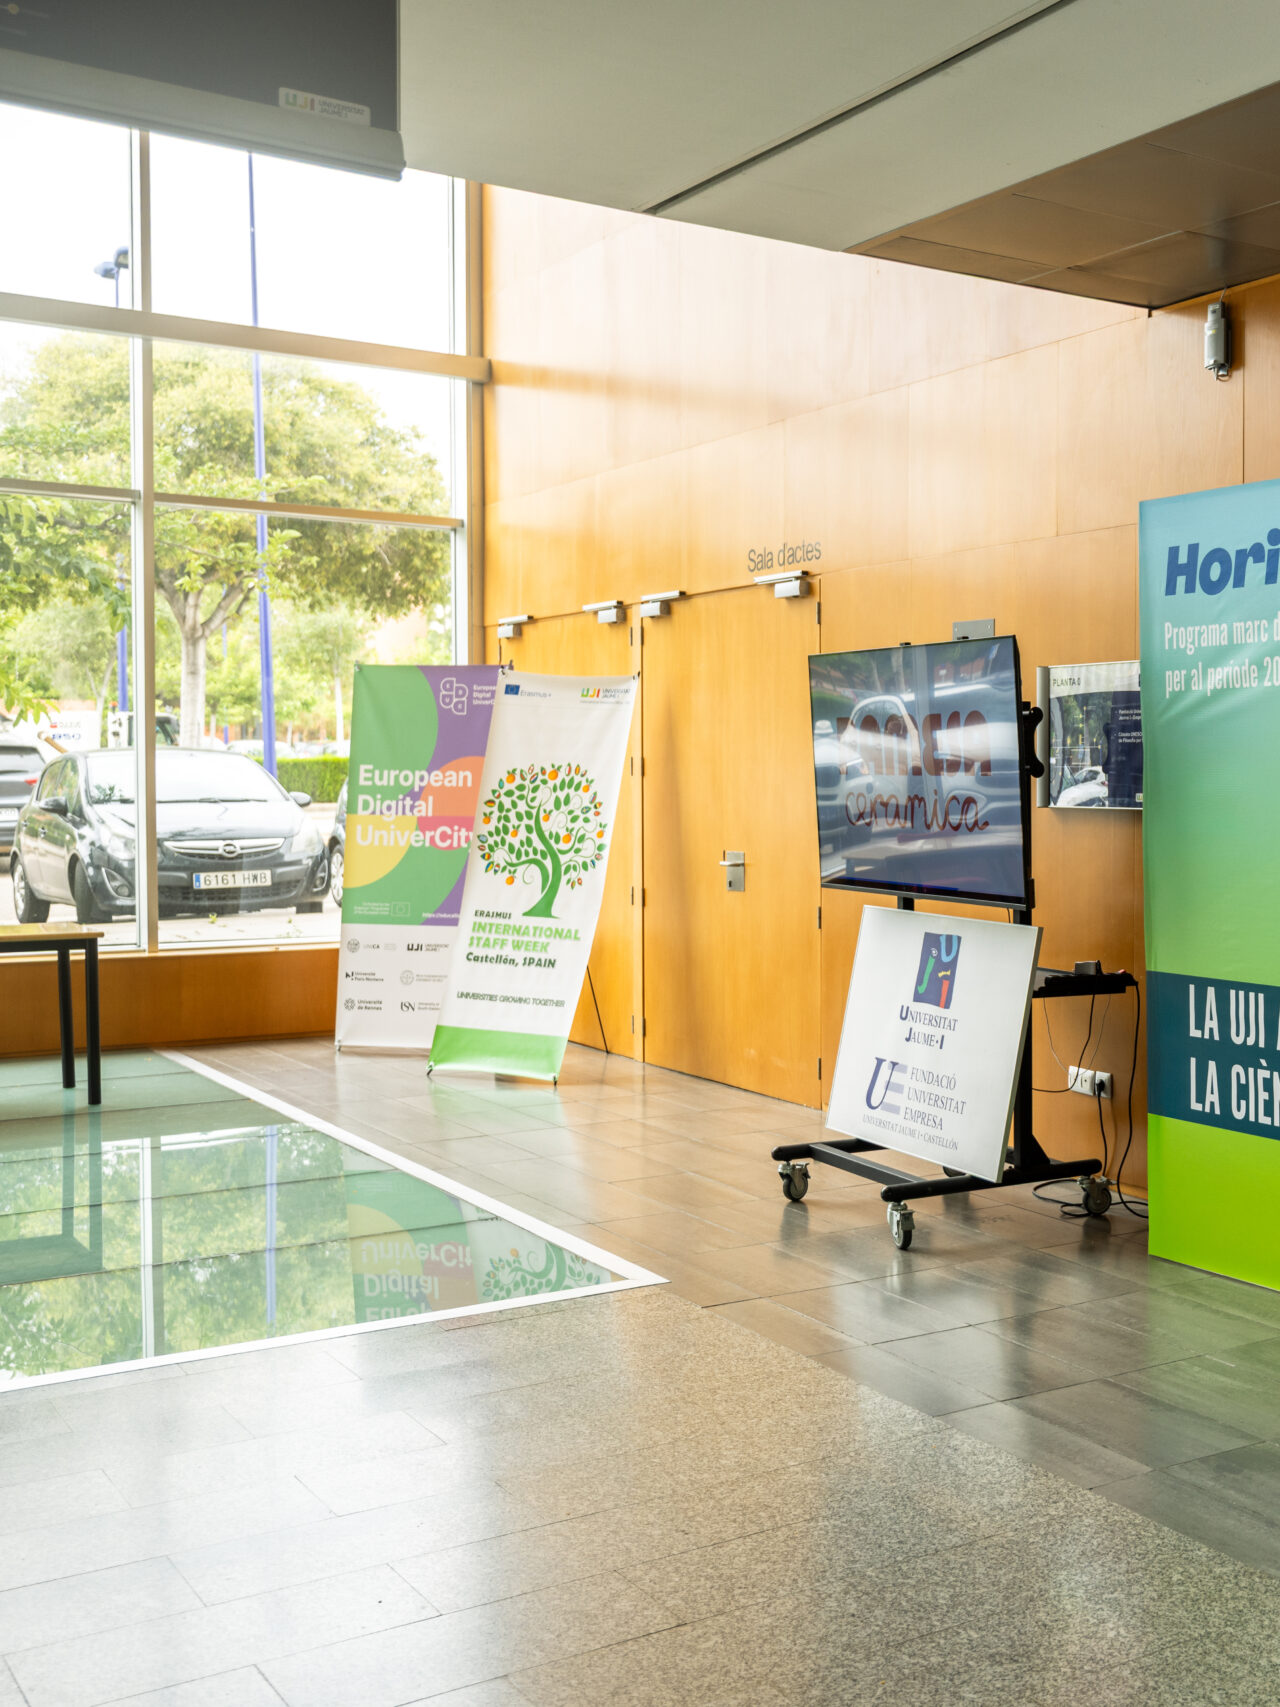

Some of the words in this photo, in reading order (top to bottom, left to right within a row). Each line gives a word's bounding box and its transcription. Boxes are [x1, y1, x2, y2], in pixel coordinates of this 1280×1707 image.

[747, 546, 774, 573] Sala
[777, 540, 822, 567] d'actes
[1164, 618, 1228, 655] Programa
[1232, 619, 1268, 645] marc
[1052, 678, 1076, 688] PLANTA
[1164, 666, 1187, 699] per
[1191, 661, 1202, 692] al
[358, 764, 473, 792] European
[357, 794, 434, 821] Digital
[204, 873, 236, 886] 6161
[243, 872, 267, 884] HWB
[474, 910, 512, 919] ERASMUS
[471, 921, 581, 941] INTERNATIONAL
[407, 943, 423, 951] UJI
[468, 936, 509, 949] STAFF
[511, 939, 550, 953] WEEK
[466, 952, 519, 967] Castellón,
[522, 957, 556, 968] SPAIN
[899, 1004, 959, 1032] UNIVERSITAT
[1188, 983, 1220, 1041] LA
[1229, 989, 1265, 1048] UJI
[910, 1066, 957, 1091] FUNDACIÓ
[1189, 1057, 1221, 1115] LA
[907, 1086, 967, 1115] UNIVERSITAT
[862, 1113, 899, 1133] UNIVERSITAT
[898, 1124, 917, 1139] JAUME
[903, 1105, 943, 1131] EMPRESA
